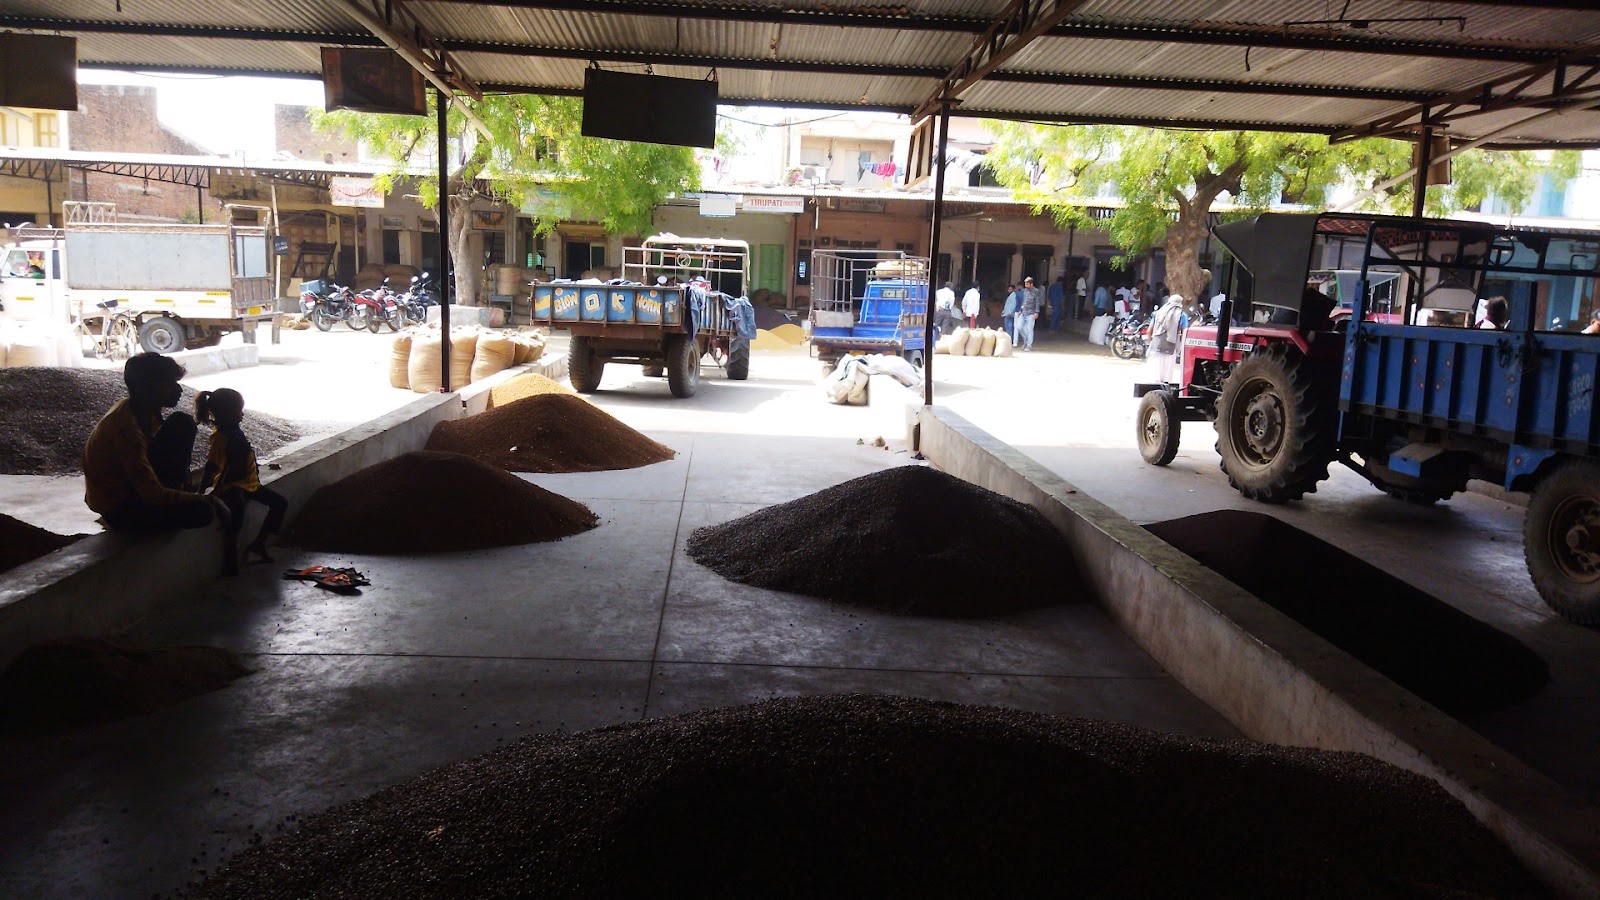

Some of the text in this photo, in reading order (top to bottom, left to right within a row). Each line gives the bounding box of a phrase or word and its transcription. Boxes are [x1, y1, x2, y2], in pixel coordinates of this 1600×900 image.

[750, 198, 783, 207] TIRUPATI
[553, 291, 579, 315] BLOW
[636, 293, 661, 315] HORN
